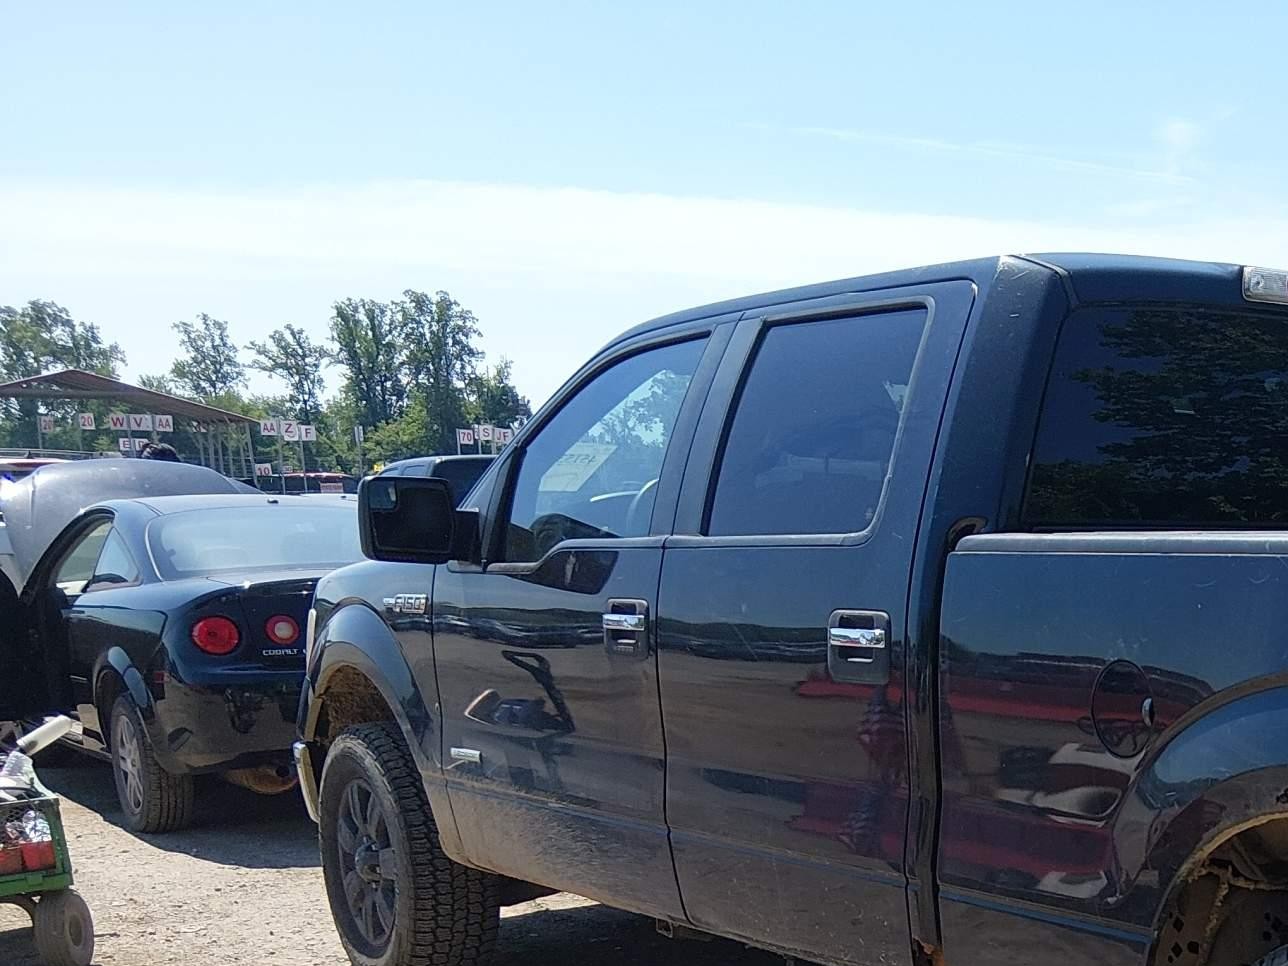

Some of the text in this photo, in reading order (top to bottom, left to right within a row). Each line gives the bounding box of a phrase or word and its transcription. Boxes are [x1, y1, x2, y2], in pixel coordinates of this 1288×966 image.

[80, 417, 93, 427] 20
[111, 417, 125, 427] W
[158, 418, 171, 428] AA
[262, 423, 276, 433] AA
[285, 423, 293, 434] Z
[305, 428, 312, 438] F
[482, 427, 490, 437] S
[461, 432, 472, 442] 70
